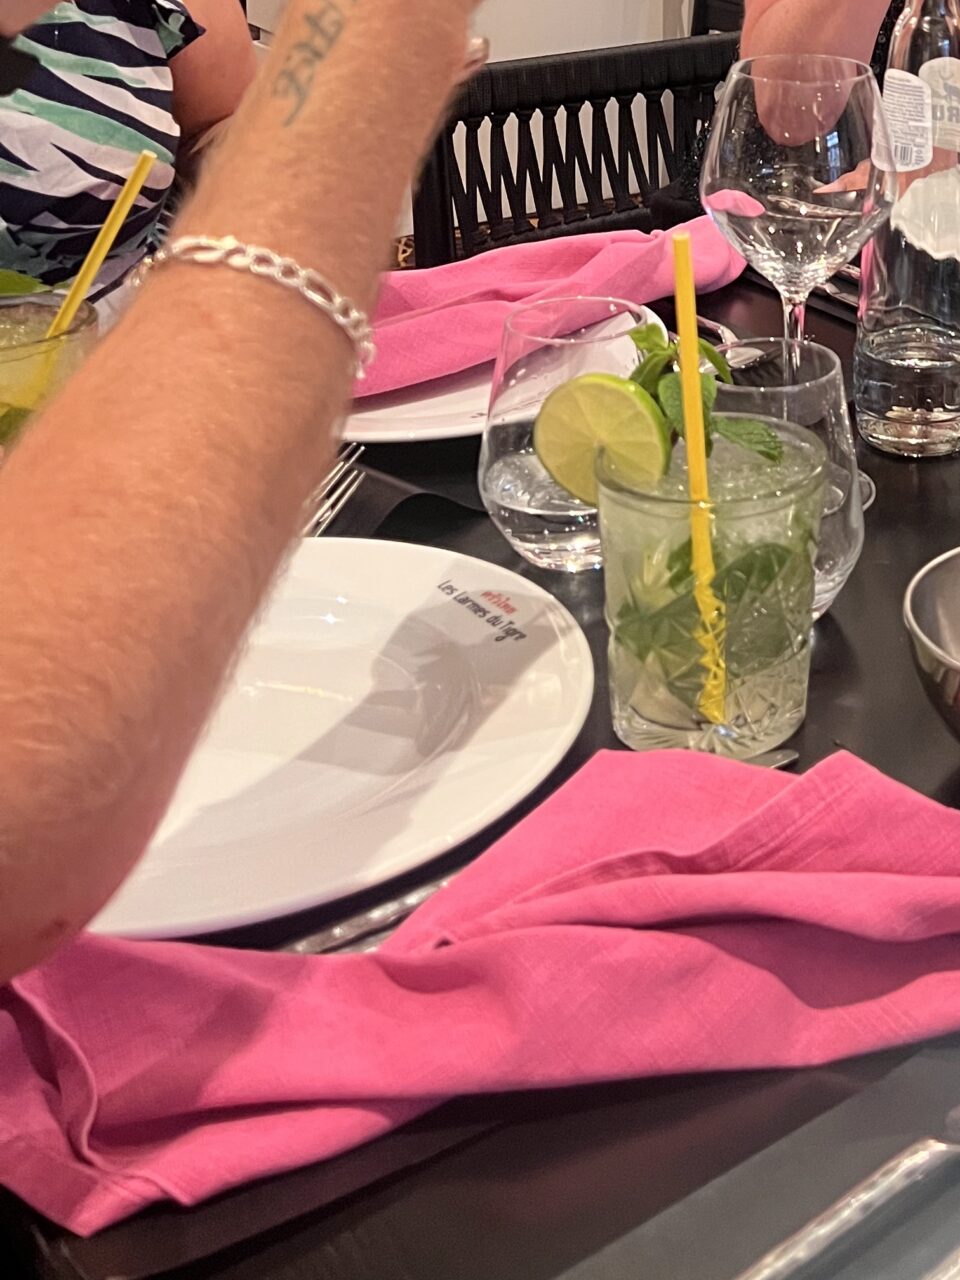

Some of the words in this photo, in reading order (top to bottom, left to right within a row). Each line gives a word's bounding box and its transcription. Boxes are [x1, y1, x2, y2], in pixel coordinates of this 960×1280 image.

[437, 579, 458, 595] Les
[453, 591, 491, 618] Larmes
[486, 615, 504, 627] du
[494, 620, 527, 642] Tigre
